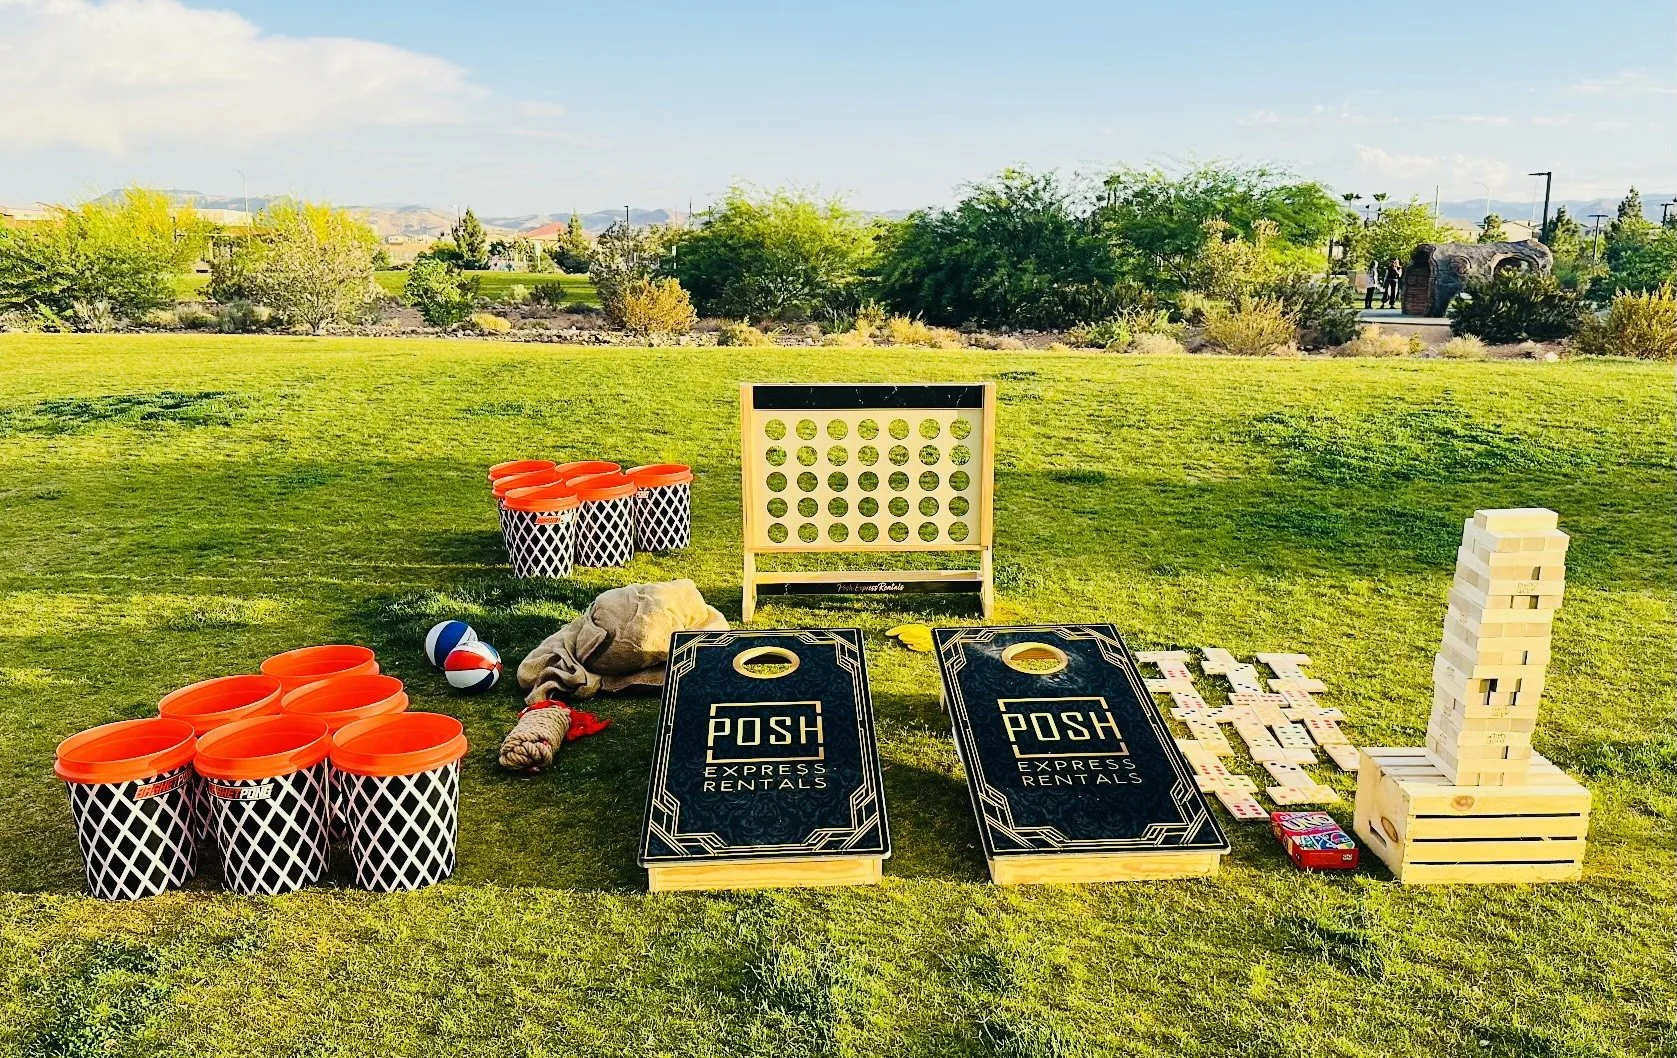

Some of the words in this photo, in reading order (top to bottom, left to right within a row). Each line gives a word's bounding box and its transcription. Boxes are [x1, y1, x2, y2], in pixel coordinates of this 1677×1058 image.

[878, 582, 905, 592] Rentals
[708, 715, 824, 747] POSH
[1002, 711, 1123, 742] POSH
[703, 763, 826, 778] EXPRESS
[1018, 759, 1136, 772] EXPRESS
[703, 778, 827, 792] RENTALS
[1022, 772, 1143, 787] RENTALS
[1280, 814, 1332, 832] UNO
